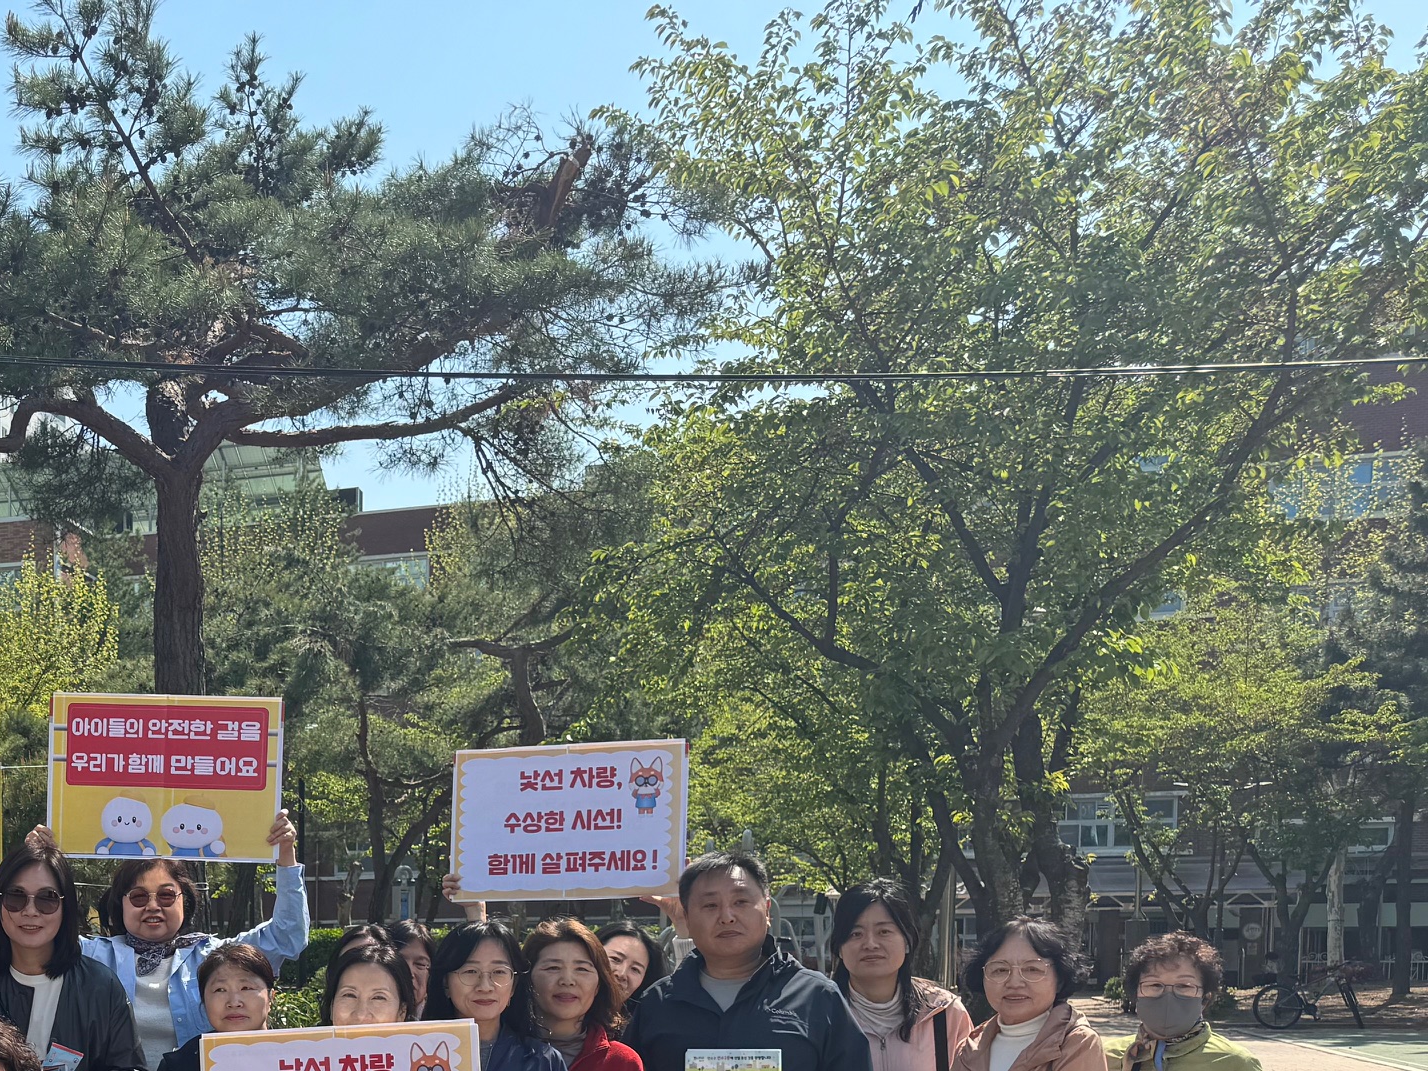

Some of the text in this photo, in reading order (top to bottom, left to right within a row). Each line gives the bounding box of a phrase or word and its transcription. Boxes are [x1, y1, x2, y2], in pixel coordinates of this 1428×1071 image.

[71, 718, 261, 741] 아이들의 안전한 걸음
[71, 752, 258, 777] 우리가 함께 만들어요
[520, 766, 622, 792] 낯선 차량,
[504, 808, 622, 834] 수상한 시선!
[488, 853, 536, 875] 함께
